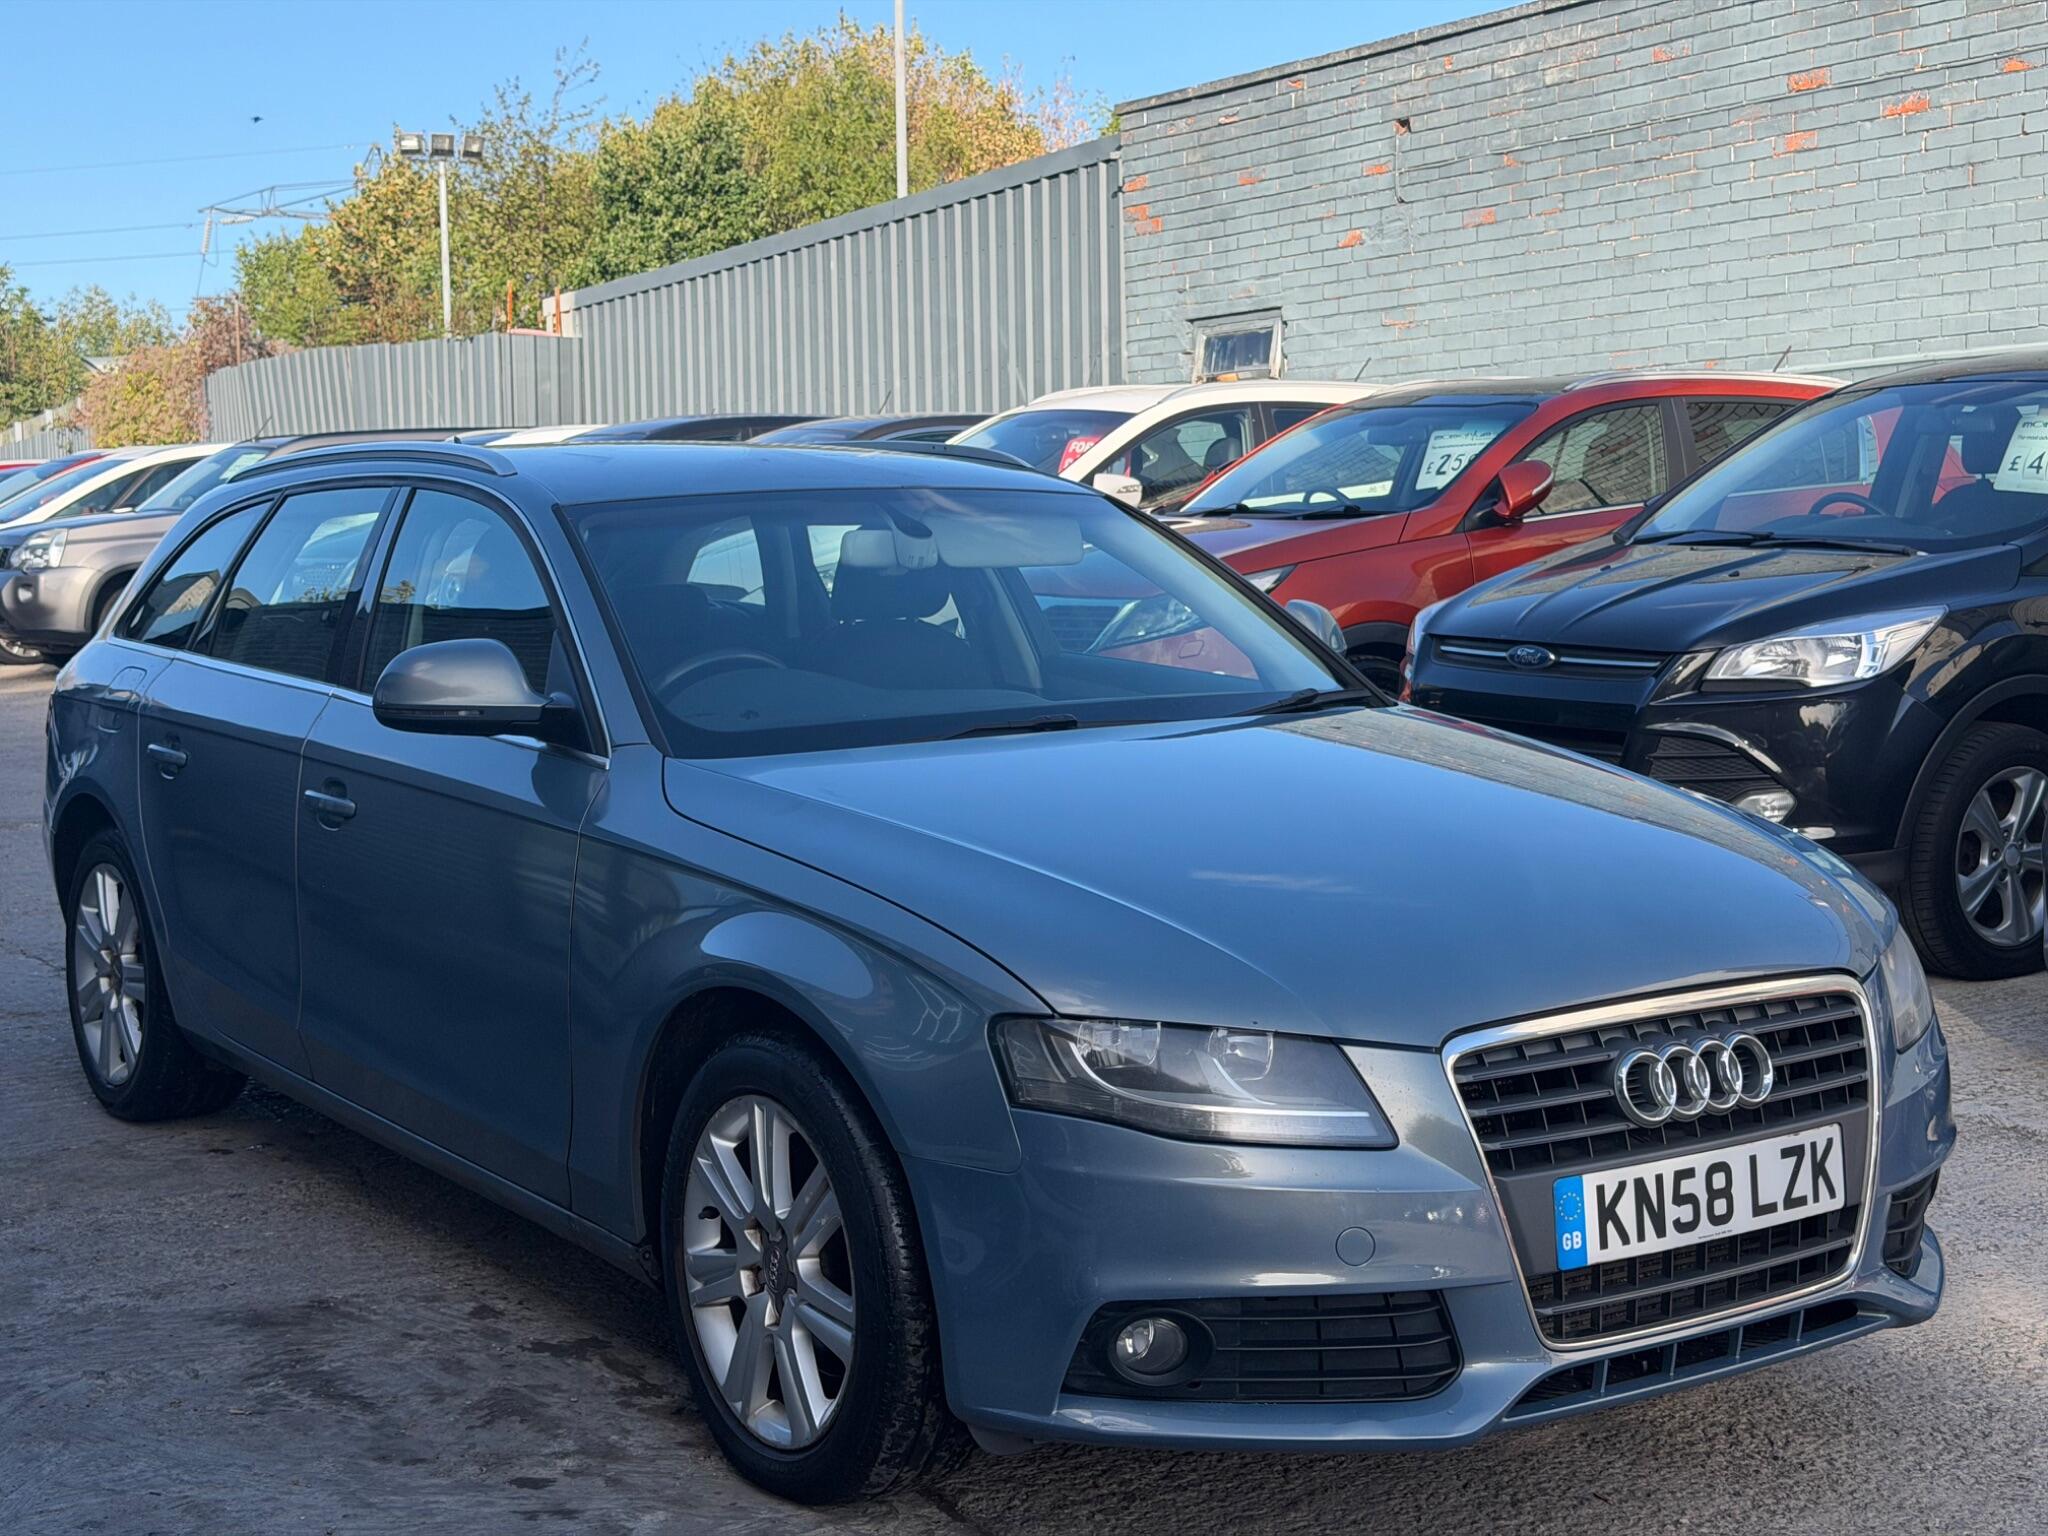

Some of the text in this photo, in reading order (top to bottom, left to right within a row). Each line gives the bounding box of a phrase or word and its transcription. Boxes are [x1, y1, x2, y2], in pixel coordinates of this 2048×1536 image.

[1595, 1137, 1838, 1251] KN58 LZK
[1562, 1231, 1582, 1251] GB
